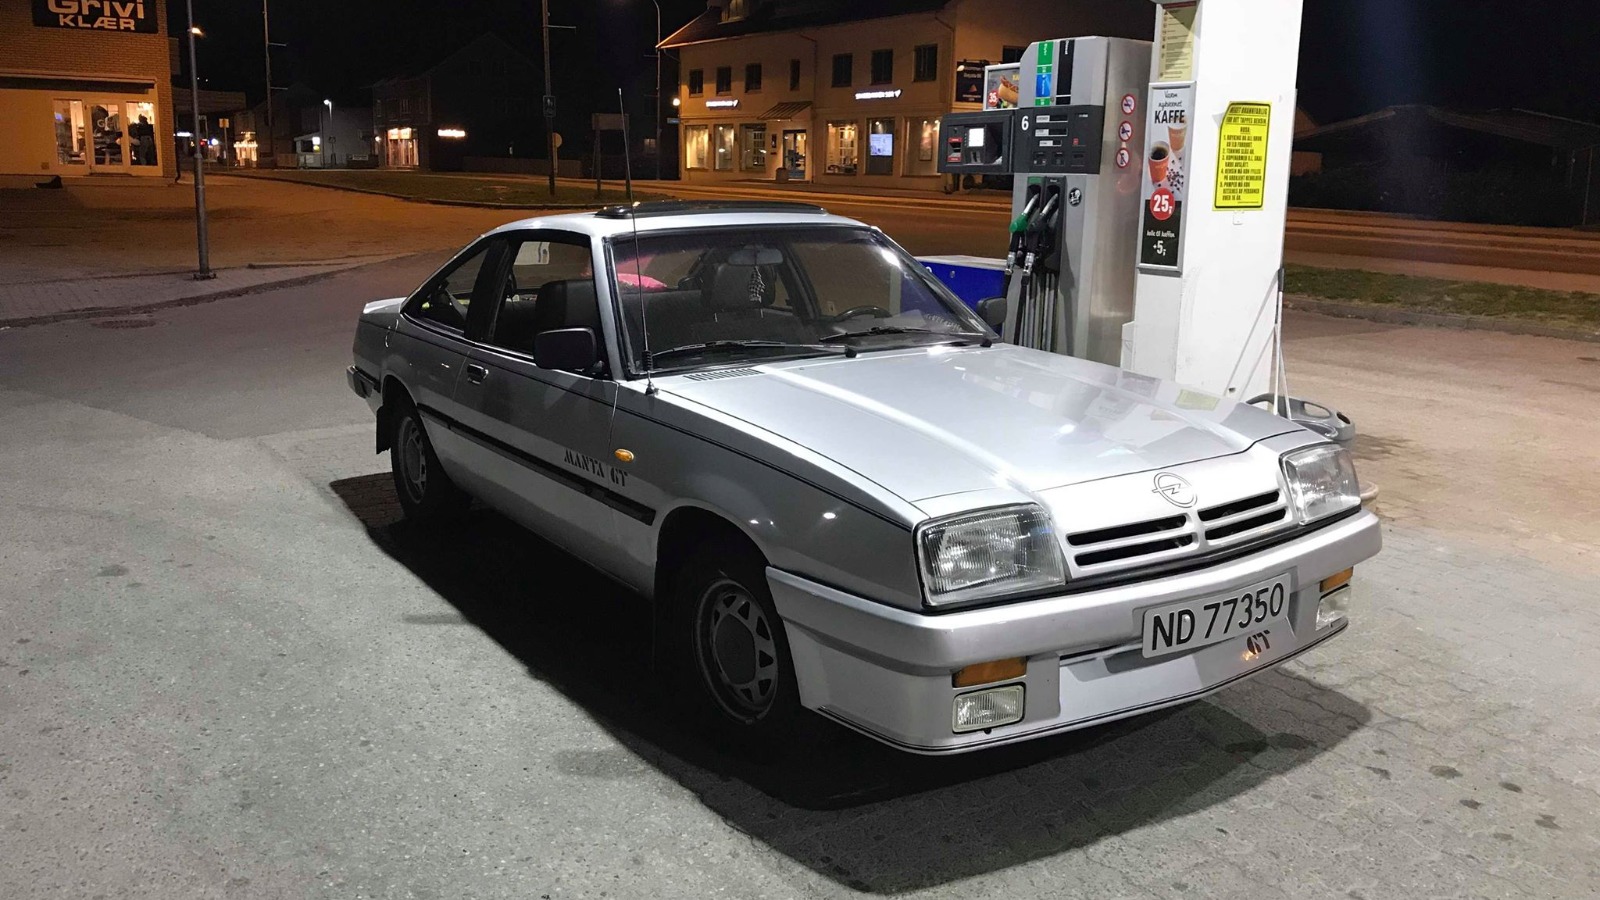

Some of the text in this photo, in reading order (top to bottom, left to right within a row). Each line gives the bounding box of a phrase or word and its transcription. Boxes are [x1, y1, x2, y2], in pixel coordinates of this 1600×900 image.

[48, 0, 145, 19] Grivi
[59, 14, 136, 31] KLÆR
[1021, 115, 1030, 131] 6
[1154, 109, 1186, 124] KAFFE
[563, 449, 629, 487] MANTA GT
[1152, 582, 1284, 651] ND 77350
[1246, 629, 1271, 655] GT
